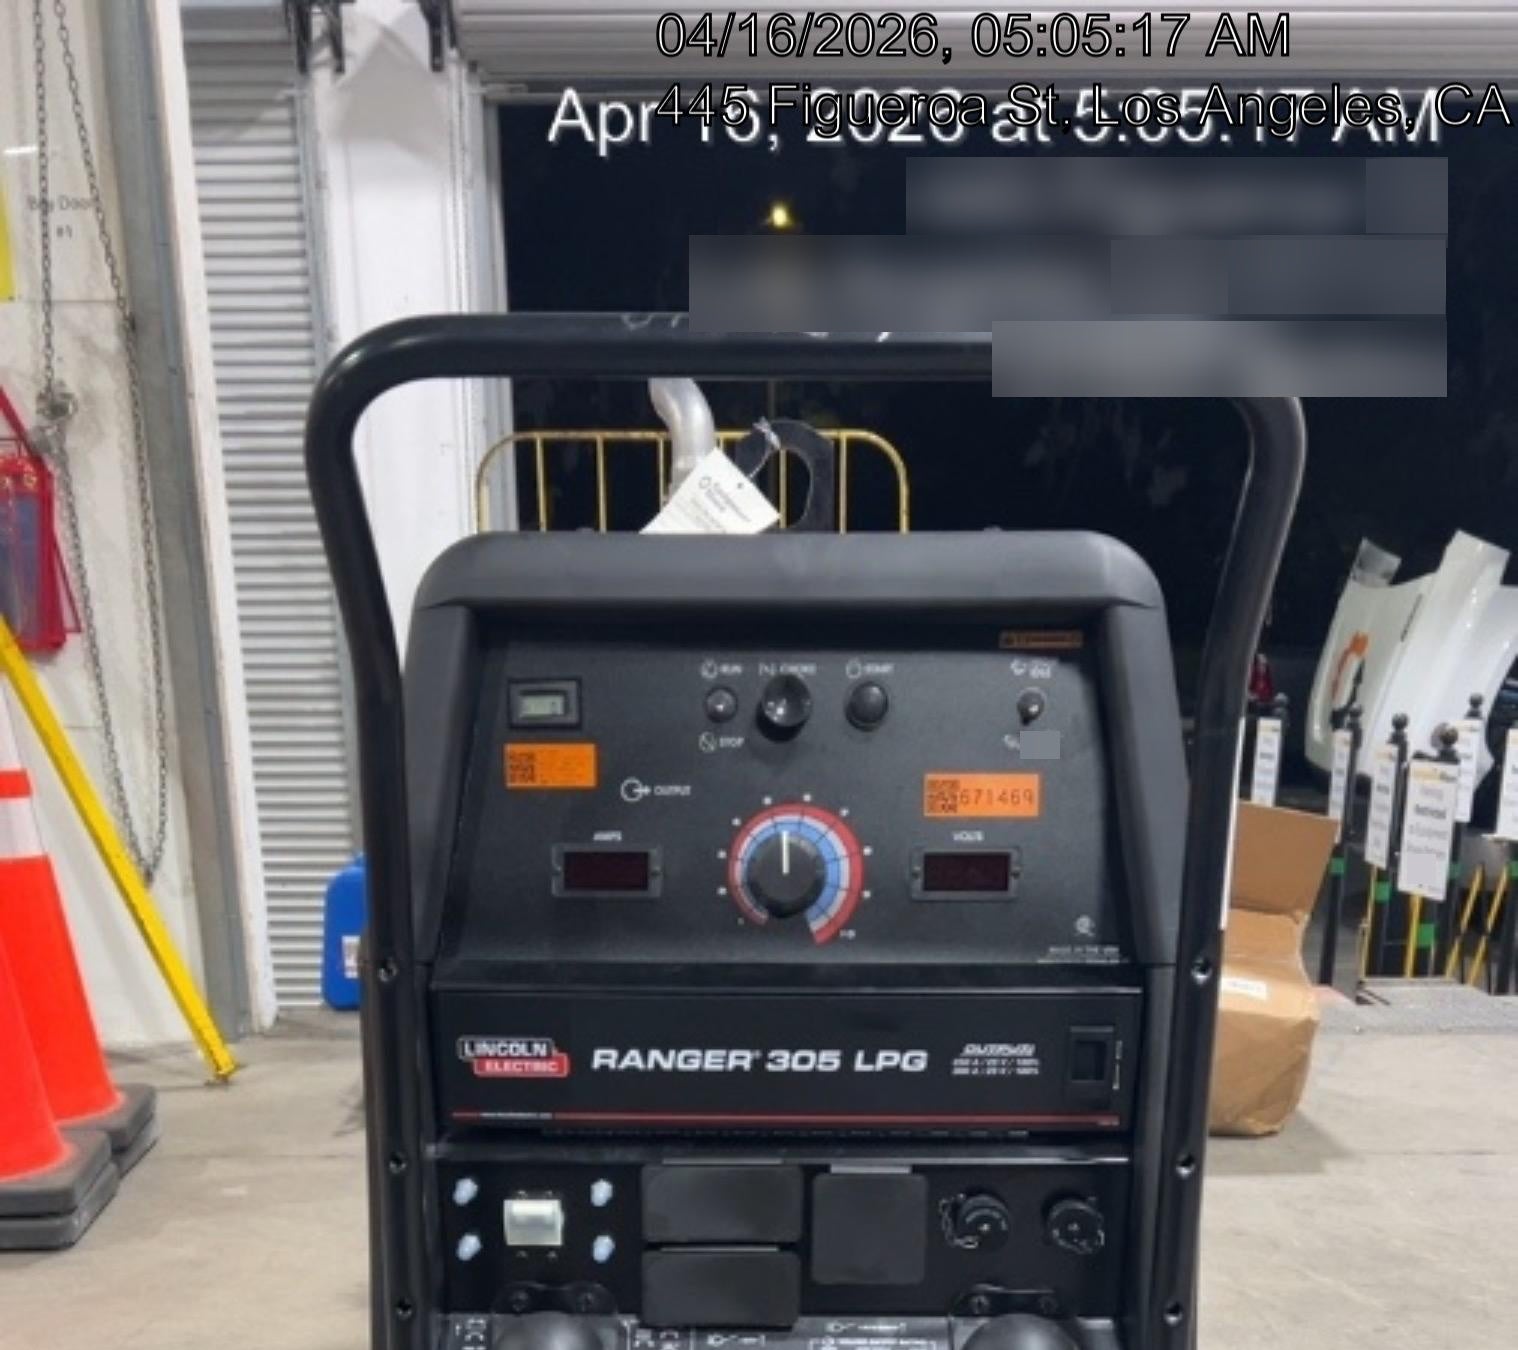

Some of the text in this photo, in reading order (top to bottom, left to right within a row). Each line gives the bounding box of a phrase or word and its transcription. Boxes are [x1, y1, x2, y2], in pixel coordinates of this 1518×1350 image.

[959, 787, 1035, 807] 671469
[464, 1040, 548, 1057] LINCOLN
[484, 1061, 560, 1073] ELECTRIC
[765, 1049, 842, 1072] 305
[853, 1049, 929, 1072] LPG
